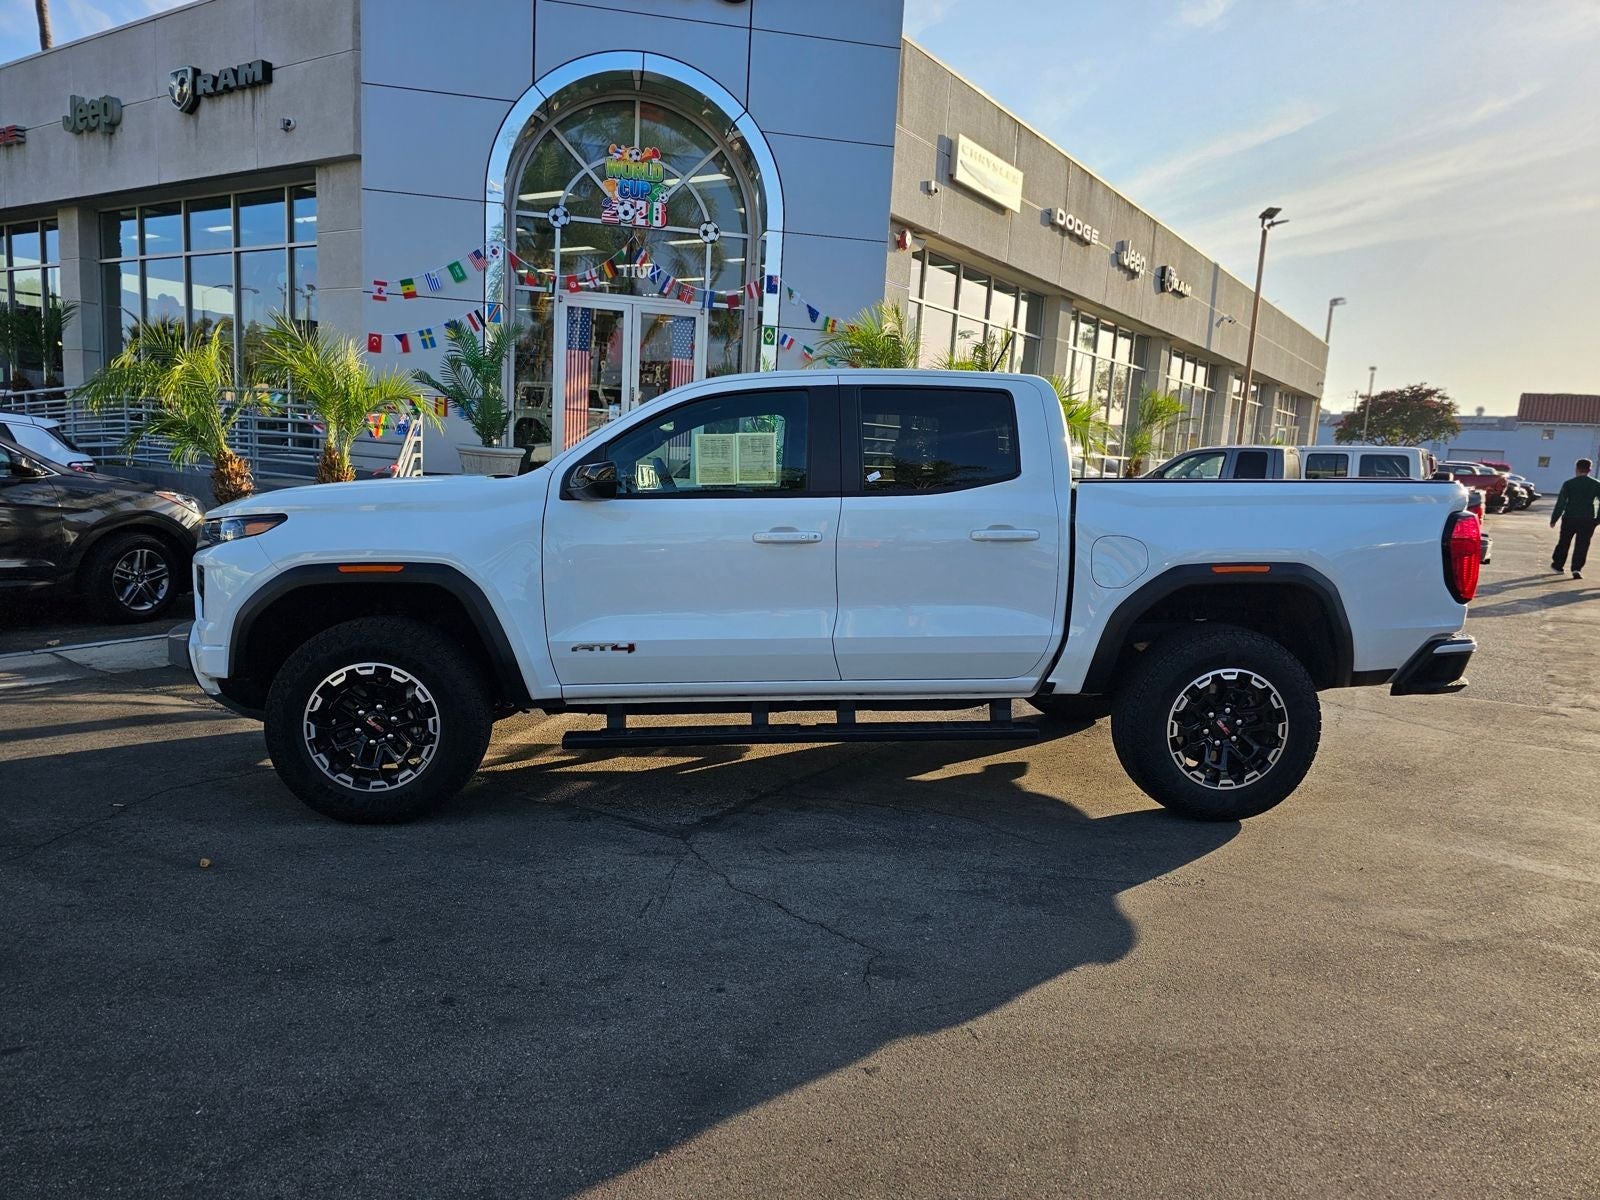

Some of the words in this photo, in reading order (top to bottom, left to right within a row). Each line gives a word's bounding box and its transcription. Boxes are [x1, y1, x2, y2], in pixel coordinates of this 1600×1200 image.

[197, 60, 267, 97] RAM
[62, 95, 121, 134] Jeep
[605, 156, 664, 182] WORLD
[618, 179, 652, 200] CUP
[1055, 207, 1100, 245] DODGE
[622, 265, 657, 279] 110
[1122, 240, 1147, 279] Jeep
[1173, 277, 1193, 297] RAM
